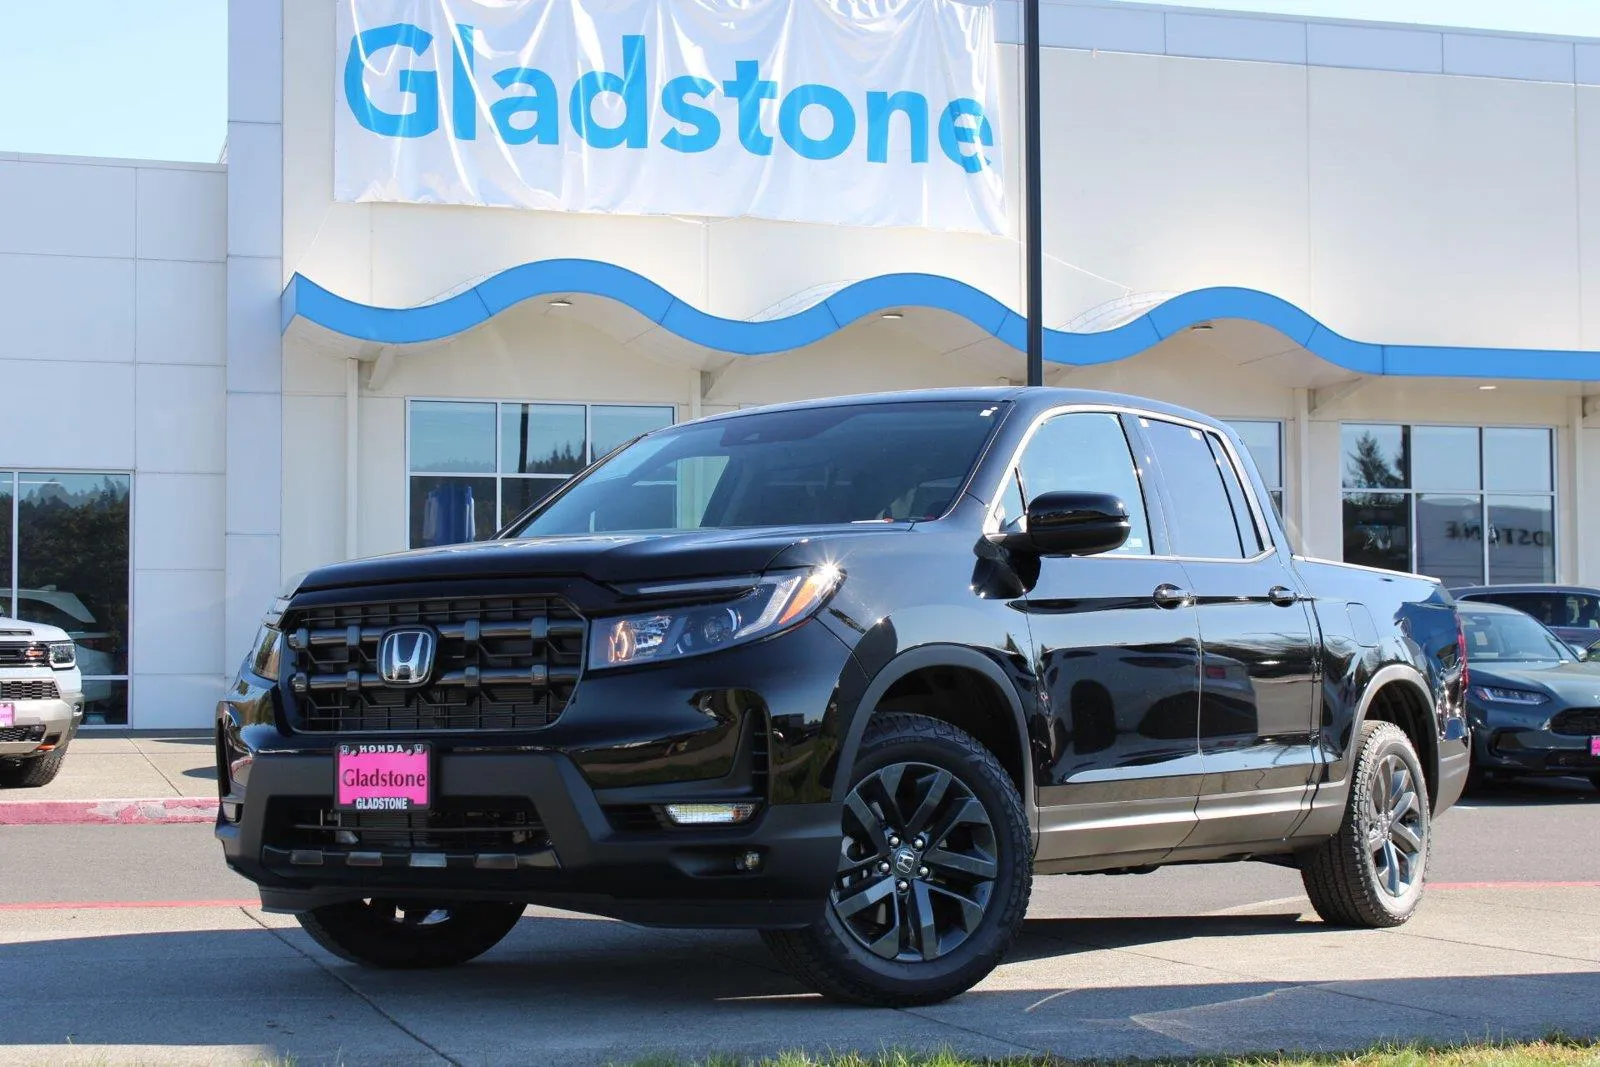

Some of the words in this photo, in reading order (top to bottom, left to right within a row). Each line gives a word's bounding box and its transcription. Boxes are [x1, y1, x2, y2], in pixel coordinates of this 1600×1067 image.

[344, 23, 994, 174] Gladstone
[360, 745, 404, 753] HONDA
[343, 768, 426, 787] Gladstone
[356, 797, 408, 810] GLADSTONE
